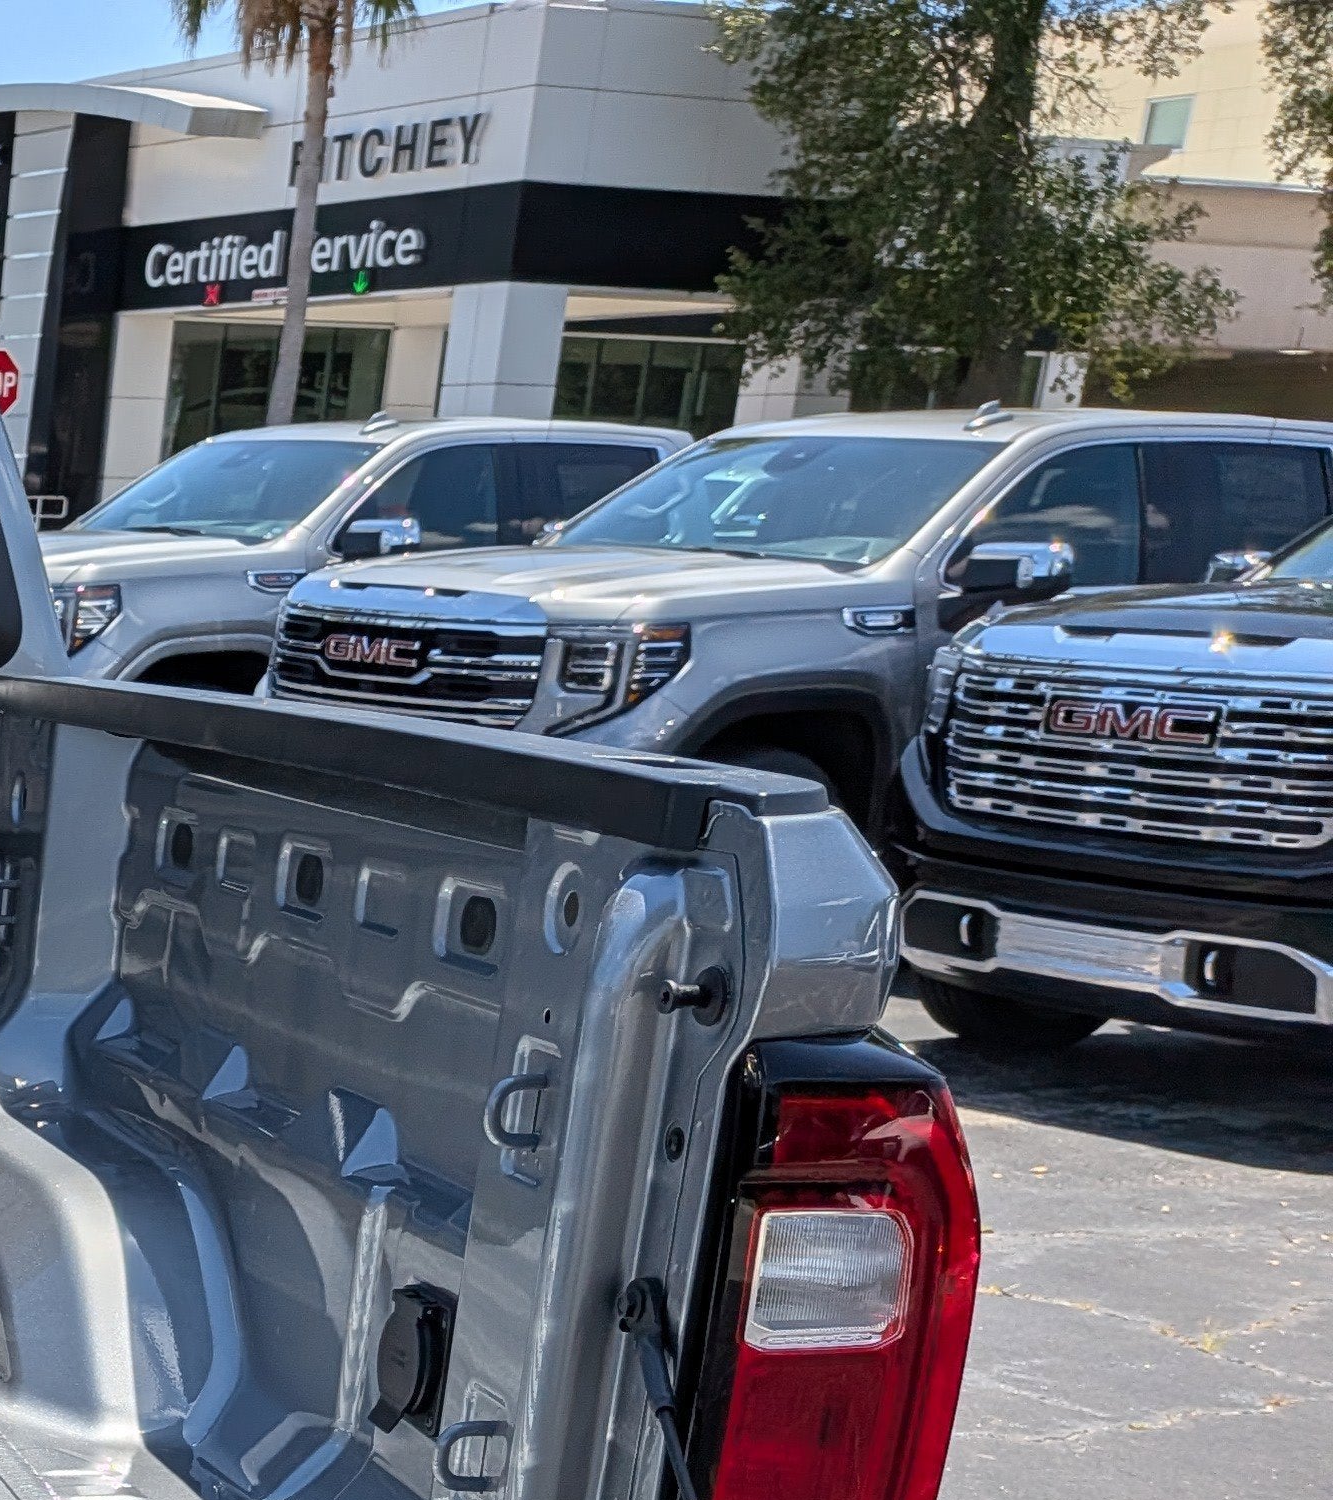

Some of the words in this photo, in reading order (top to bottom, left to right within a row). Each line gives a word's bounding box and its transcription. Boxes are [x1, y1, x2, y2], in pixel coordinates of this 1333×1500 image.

[144, 229, 283, 287] Certified
[310, 220, 422, 274] ervice
[324, 633, 421, 668] GMC
[1049, 699, 1215, 745] GMC
